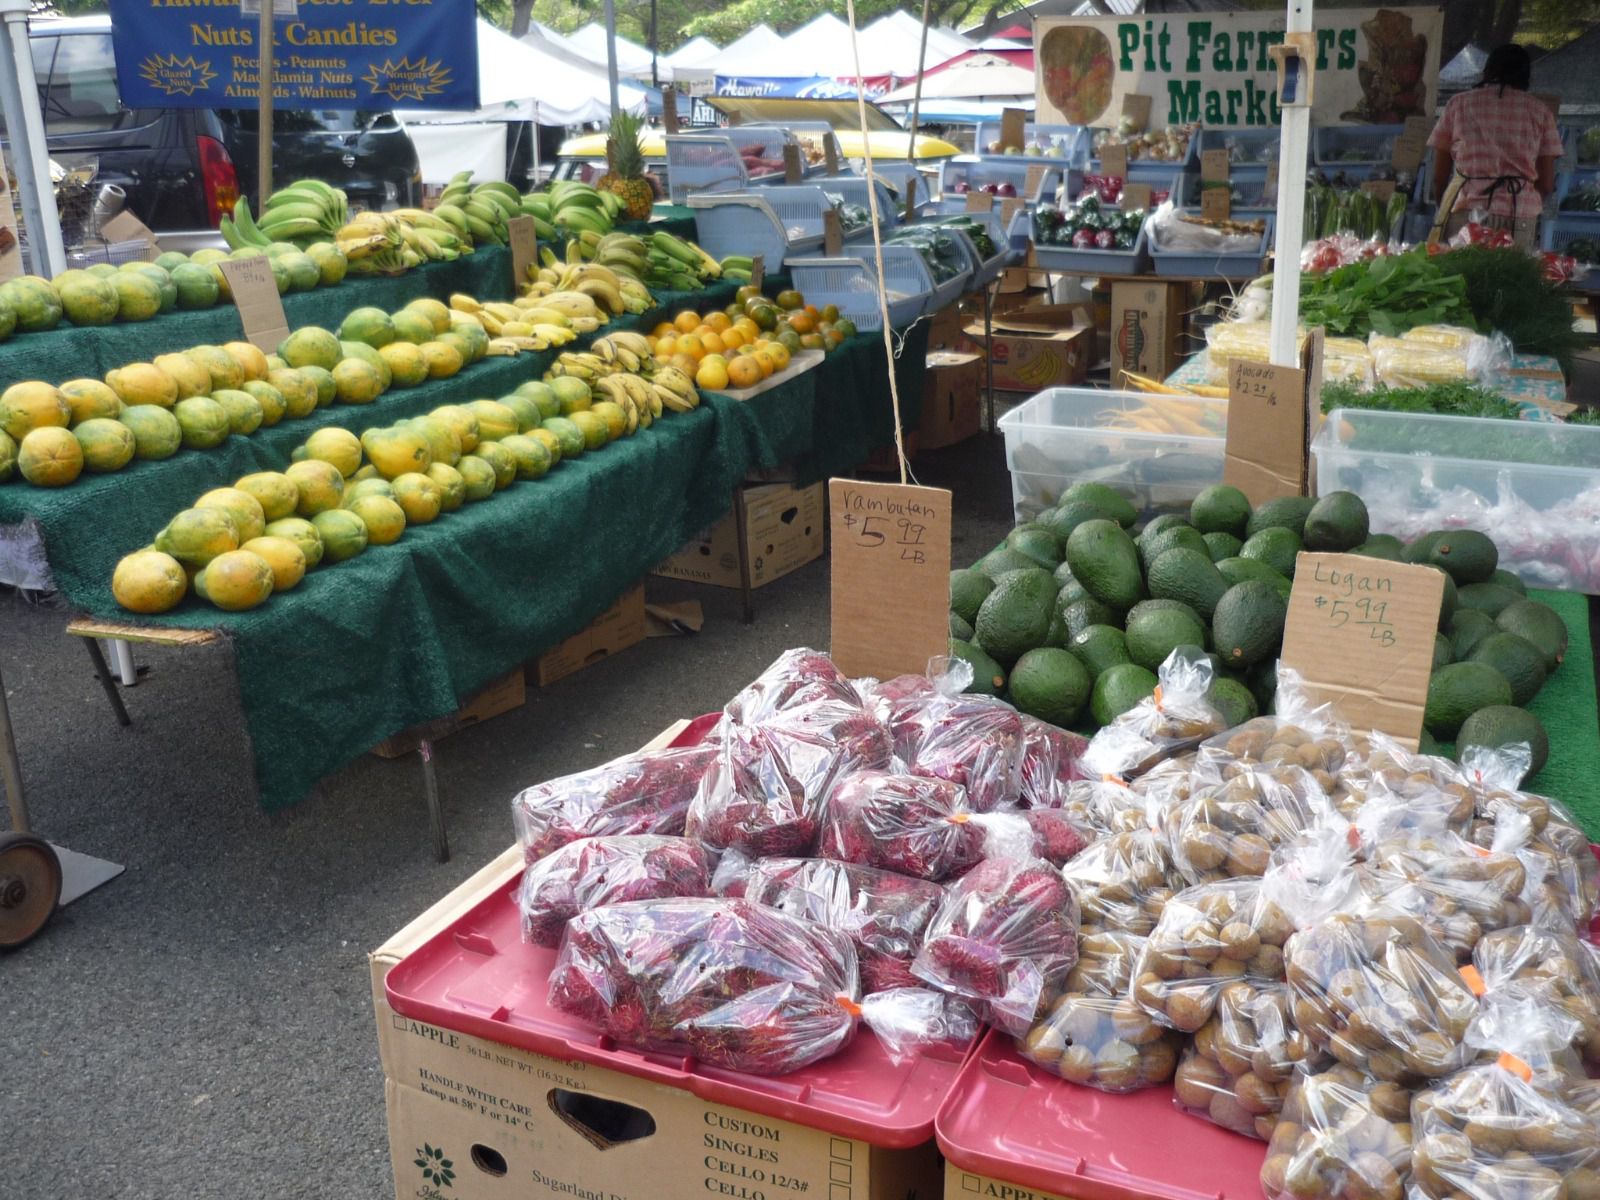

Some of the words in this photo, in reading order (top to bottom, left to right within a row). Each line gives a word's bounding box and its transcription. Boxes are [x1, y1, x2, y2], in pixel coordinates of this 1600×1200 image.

[190, 23, 253, 46] Nuts
[286, 22, 398, 46] Candies
[1117, 20, 1172, 73] Pit
[1186, 21, 1357, 73] Farmrs
[232, 55, 281, 68] Pecas
[290, 55, 347, 69] Peanuts
[320, 71, 353, 83] Nuts
[225, 84, 290, 98] Almods
[299, 86, 357, 99] Walnuts
[900, 548, 926, 565] LB
[1314, 561, 1392, 597] Logan
[1370, 626, 1396, 648] LB
[410, 1021, 460, 1049] APPLE
[495, 1054, 515, 1068] NET
[419, 1067, 464, 1093] HANDLE
[465, 1084, 498, 1106] WITH
[499, 1097, 533, 1117] CARE
[420, 1082, 447, 1101] Keep
[448, 1095, 459, 1105] at
[480, 1104, 488, 1115] F
[489, 1110, 502, 1121] or
[524, 1120, 534, 1132] C
[703, 1111, 780, 1142] CUSTOM
[703, 1133, 779, 1163] SINGLES
[531, 1169, 604, 1200] Sugarland
[703, 1155, 765, 1182] CELLO
[770, 1173, 809, 1193] 12/3#
[703, 1176, 765, 1200] CELLO
